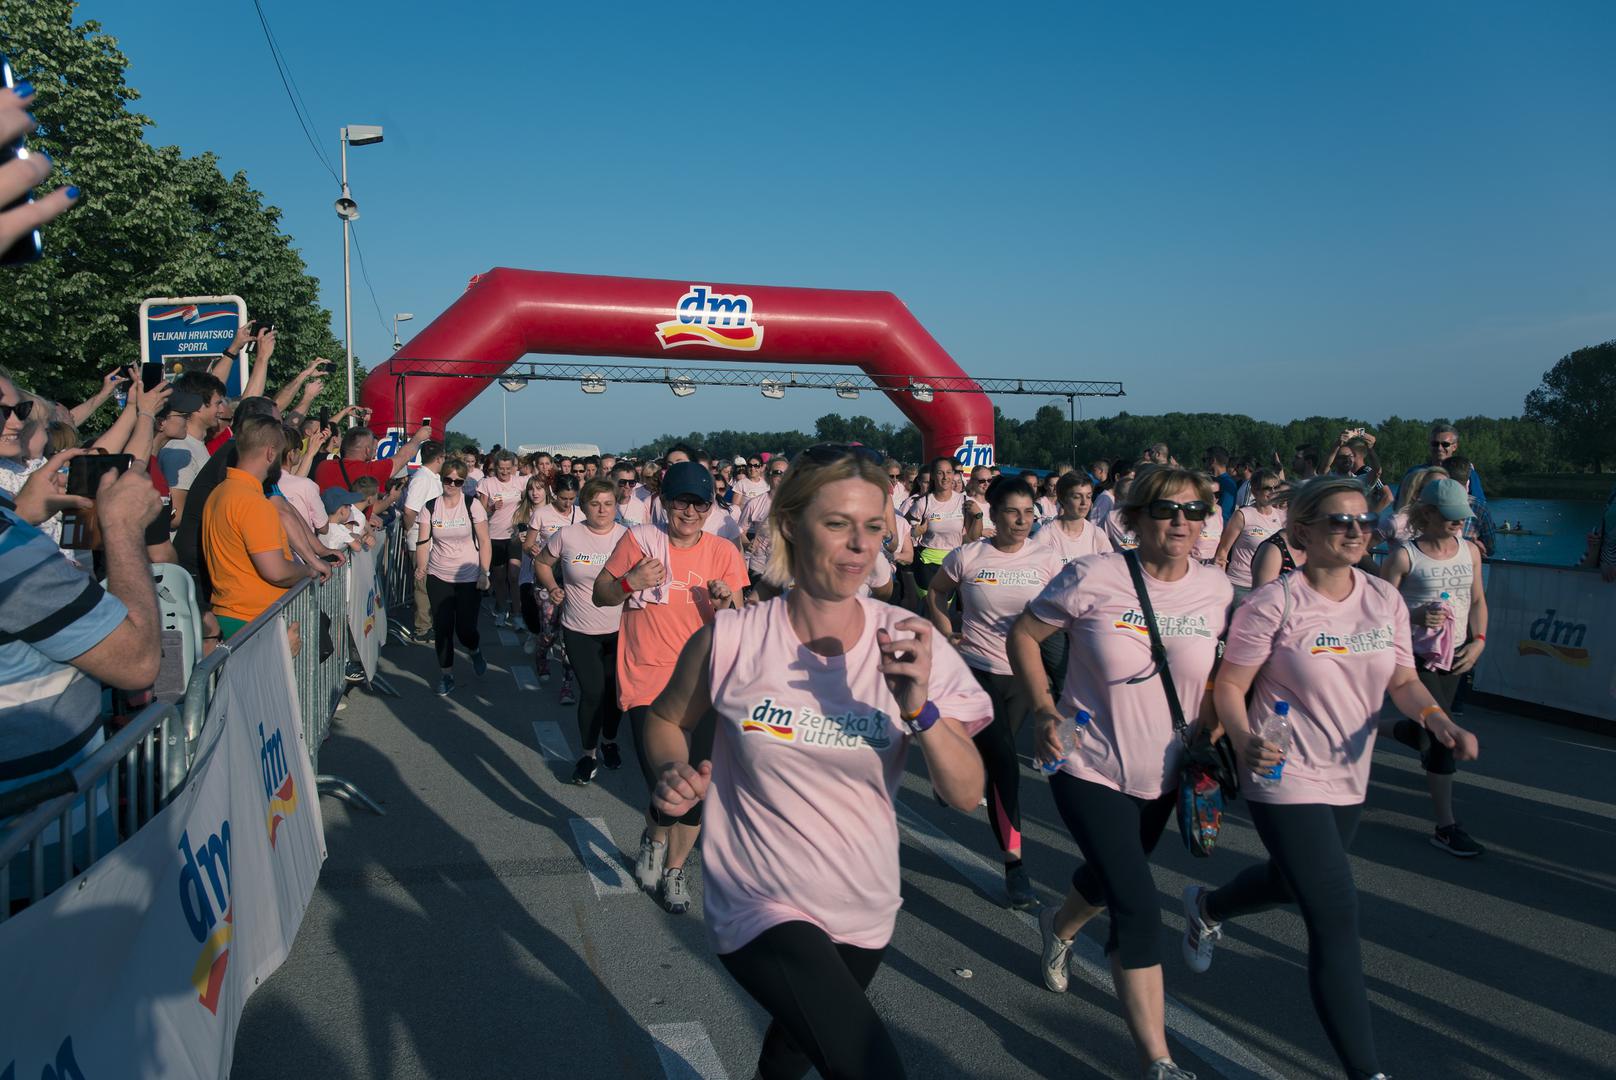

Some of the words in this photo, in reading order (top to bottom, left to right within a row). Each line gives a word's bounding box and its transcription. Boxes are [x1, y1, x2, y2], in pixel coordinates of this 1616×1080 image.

[680, 288, 748, 327] dm
[152, 331, 187, 342] VELIKANI
[188, 329, 234, 340] HRVATSKOG
[178, 342, 208, 352] SPORTA
[954, 439, 993, 467] dm
[575, 552, 590, 561] dm
[977, 569, 996, 579] dm
[1529, 608, 1587, 648] dm
[1315, 632, 1341, 648] dm
[752, 699, 793, 727] dm
[799, 708, 869, 733] ženska
[803, 729, 859, 748] utrka
[258, 721, 288, 803] dm
[178, 819, 232, 944] dm
